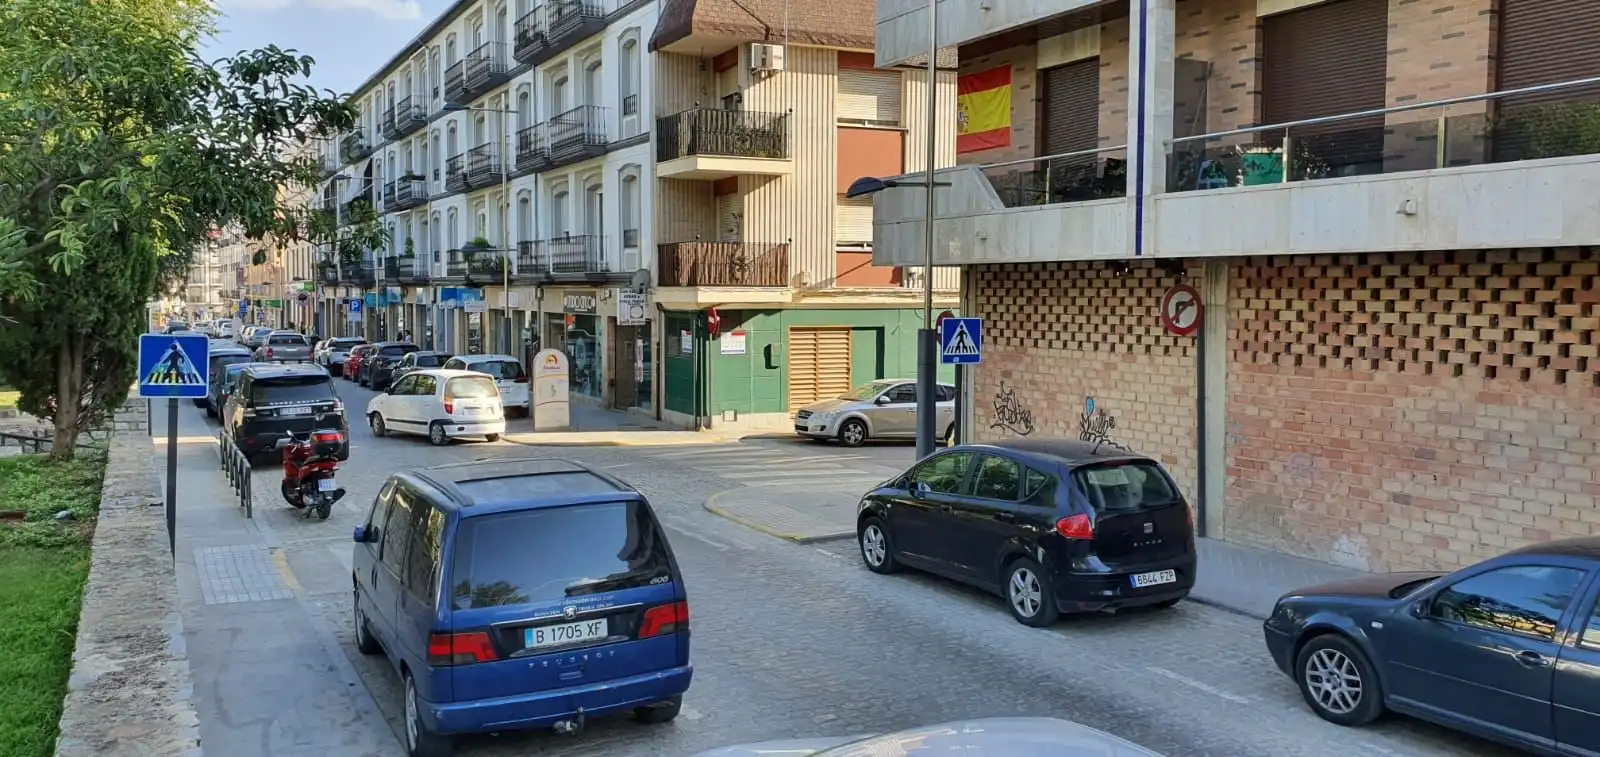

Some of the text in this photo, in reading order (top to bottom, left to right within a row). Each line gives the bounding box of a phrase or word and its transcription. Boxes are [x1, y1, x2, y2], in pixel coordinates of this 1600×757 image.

[536, 621, 603, 644] B 1705 XF
